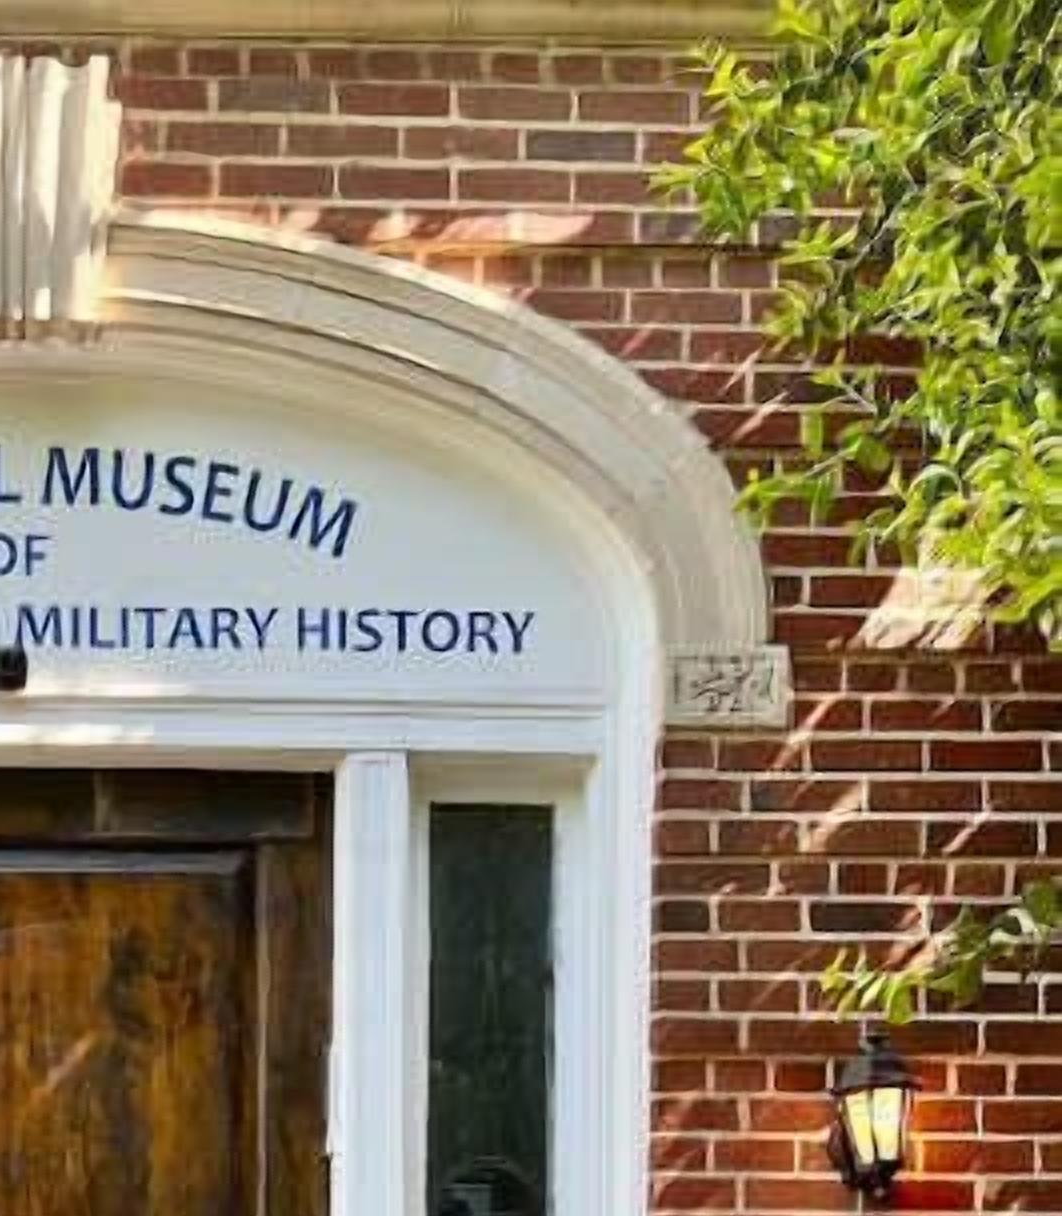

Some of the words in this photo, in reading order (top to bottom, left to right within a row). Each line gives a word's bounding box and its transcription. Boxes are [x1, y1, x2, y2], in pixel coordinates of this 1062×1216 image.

[40, 445, 357, 558] MUSEUM
[14, 603, 279, 650] MILITARY
[297, 607, 535, 654] HISTORY
